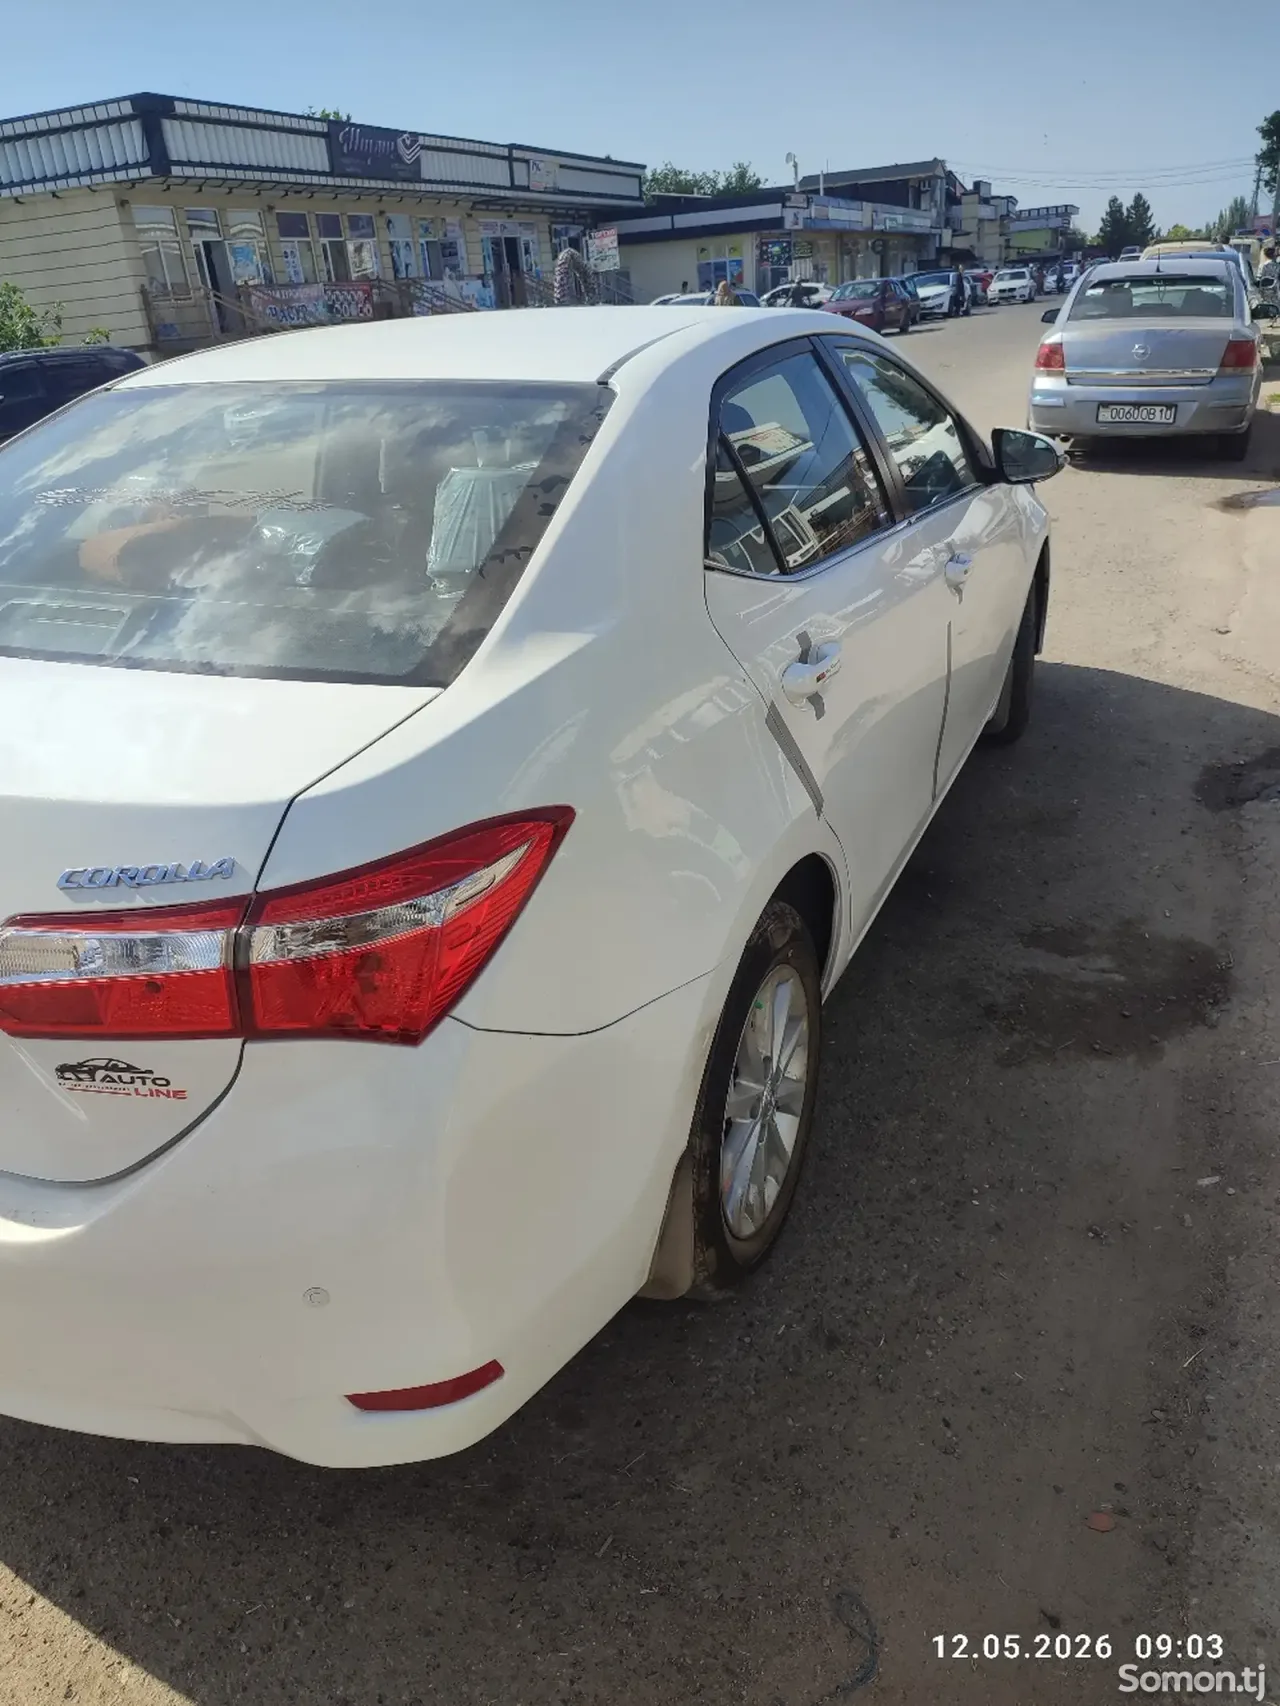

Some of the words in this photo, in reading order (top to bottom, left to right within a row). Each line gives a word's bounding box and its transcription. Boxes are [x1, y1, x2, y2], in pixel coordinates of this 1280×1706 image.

[56, 857, 236, 890] COROLLA
[99, 1073, 171, 1088] AUTO
[134, 1088, 188, 1100] LINE
